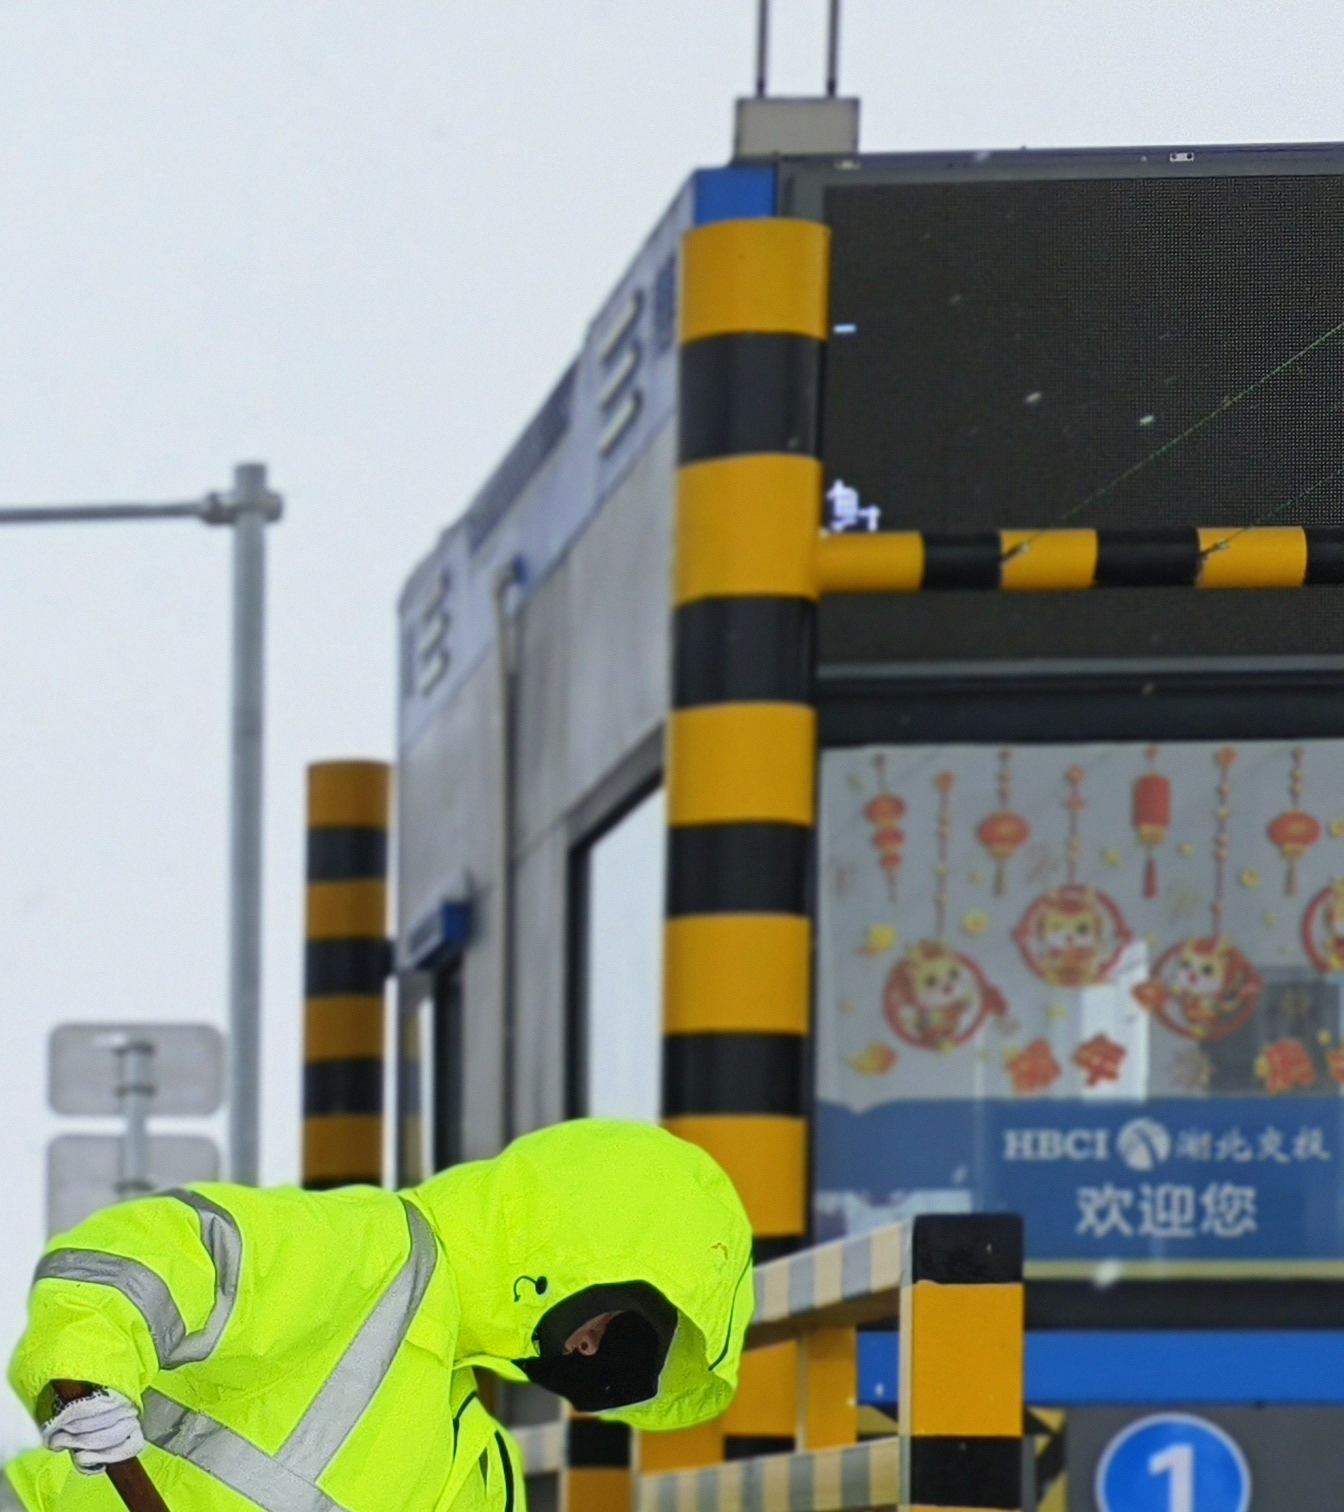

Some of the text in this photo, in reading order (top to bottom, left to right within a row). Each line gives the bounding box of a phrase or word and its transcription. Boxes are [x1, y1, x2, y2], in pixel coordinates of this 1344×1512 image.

[1004, 1129, 1109, 1160] HBCI
[1075, 1182, 1257, 1238] 欢迎您
